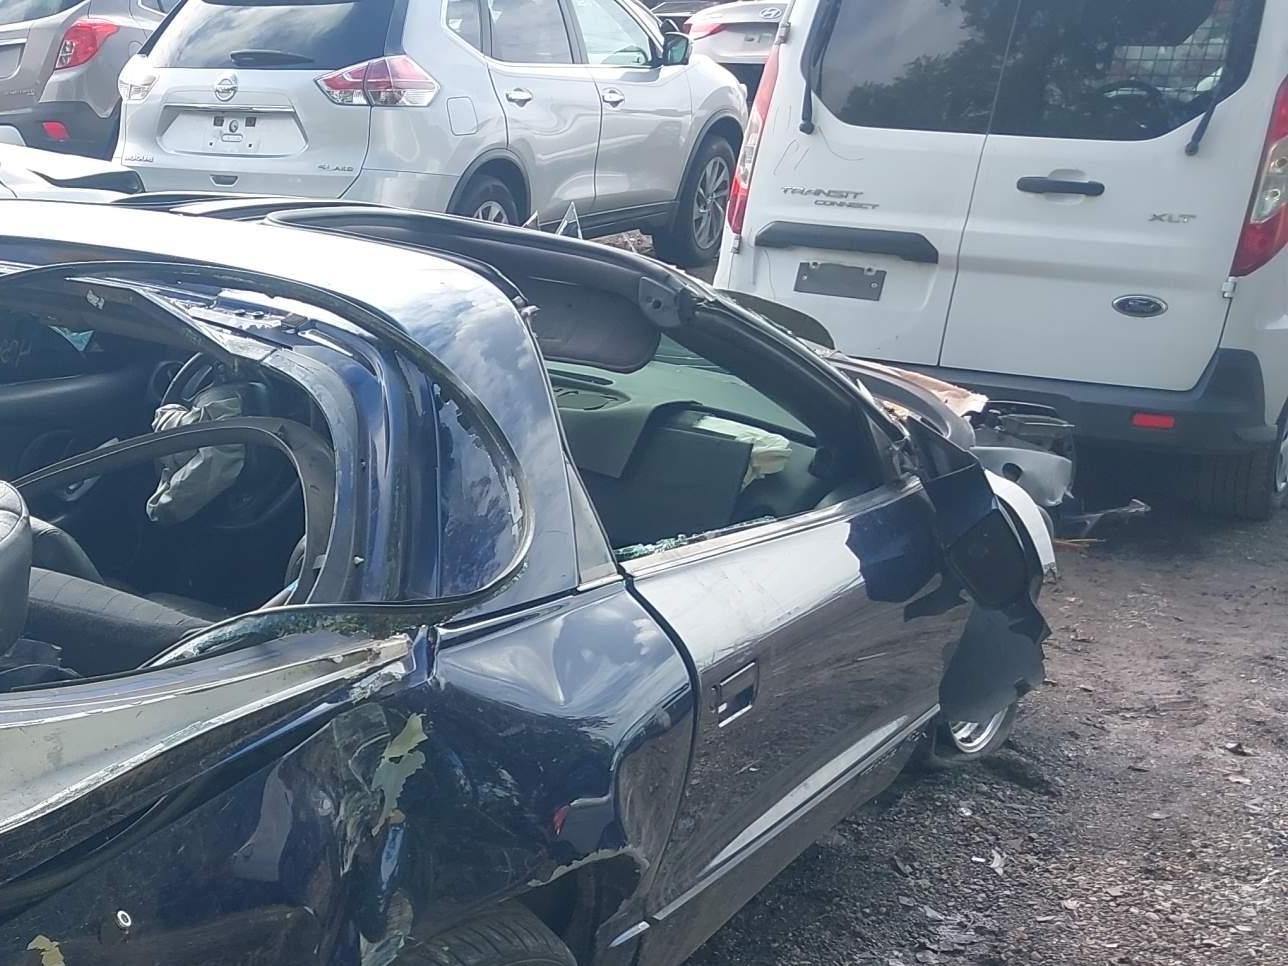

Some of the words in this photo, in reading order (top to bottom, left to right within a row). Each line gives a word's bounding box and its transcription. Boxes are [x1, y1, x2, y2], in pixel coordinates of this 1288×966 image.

[782, 186, 864, 200] TRANSIT
[814, 199, 880, 210] CONNECT
[1148, 212, 1197, 224] XLT
